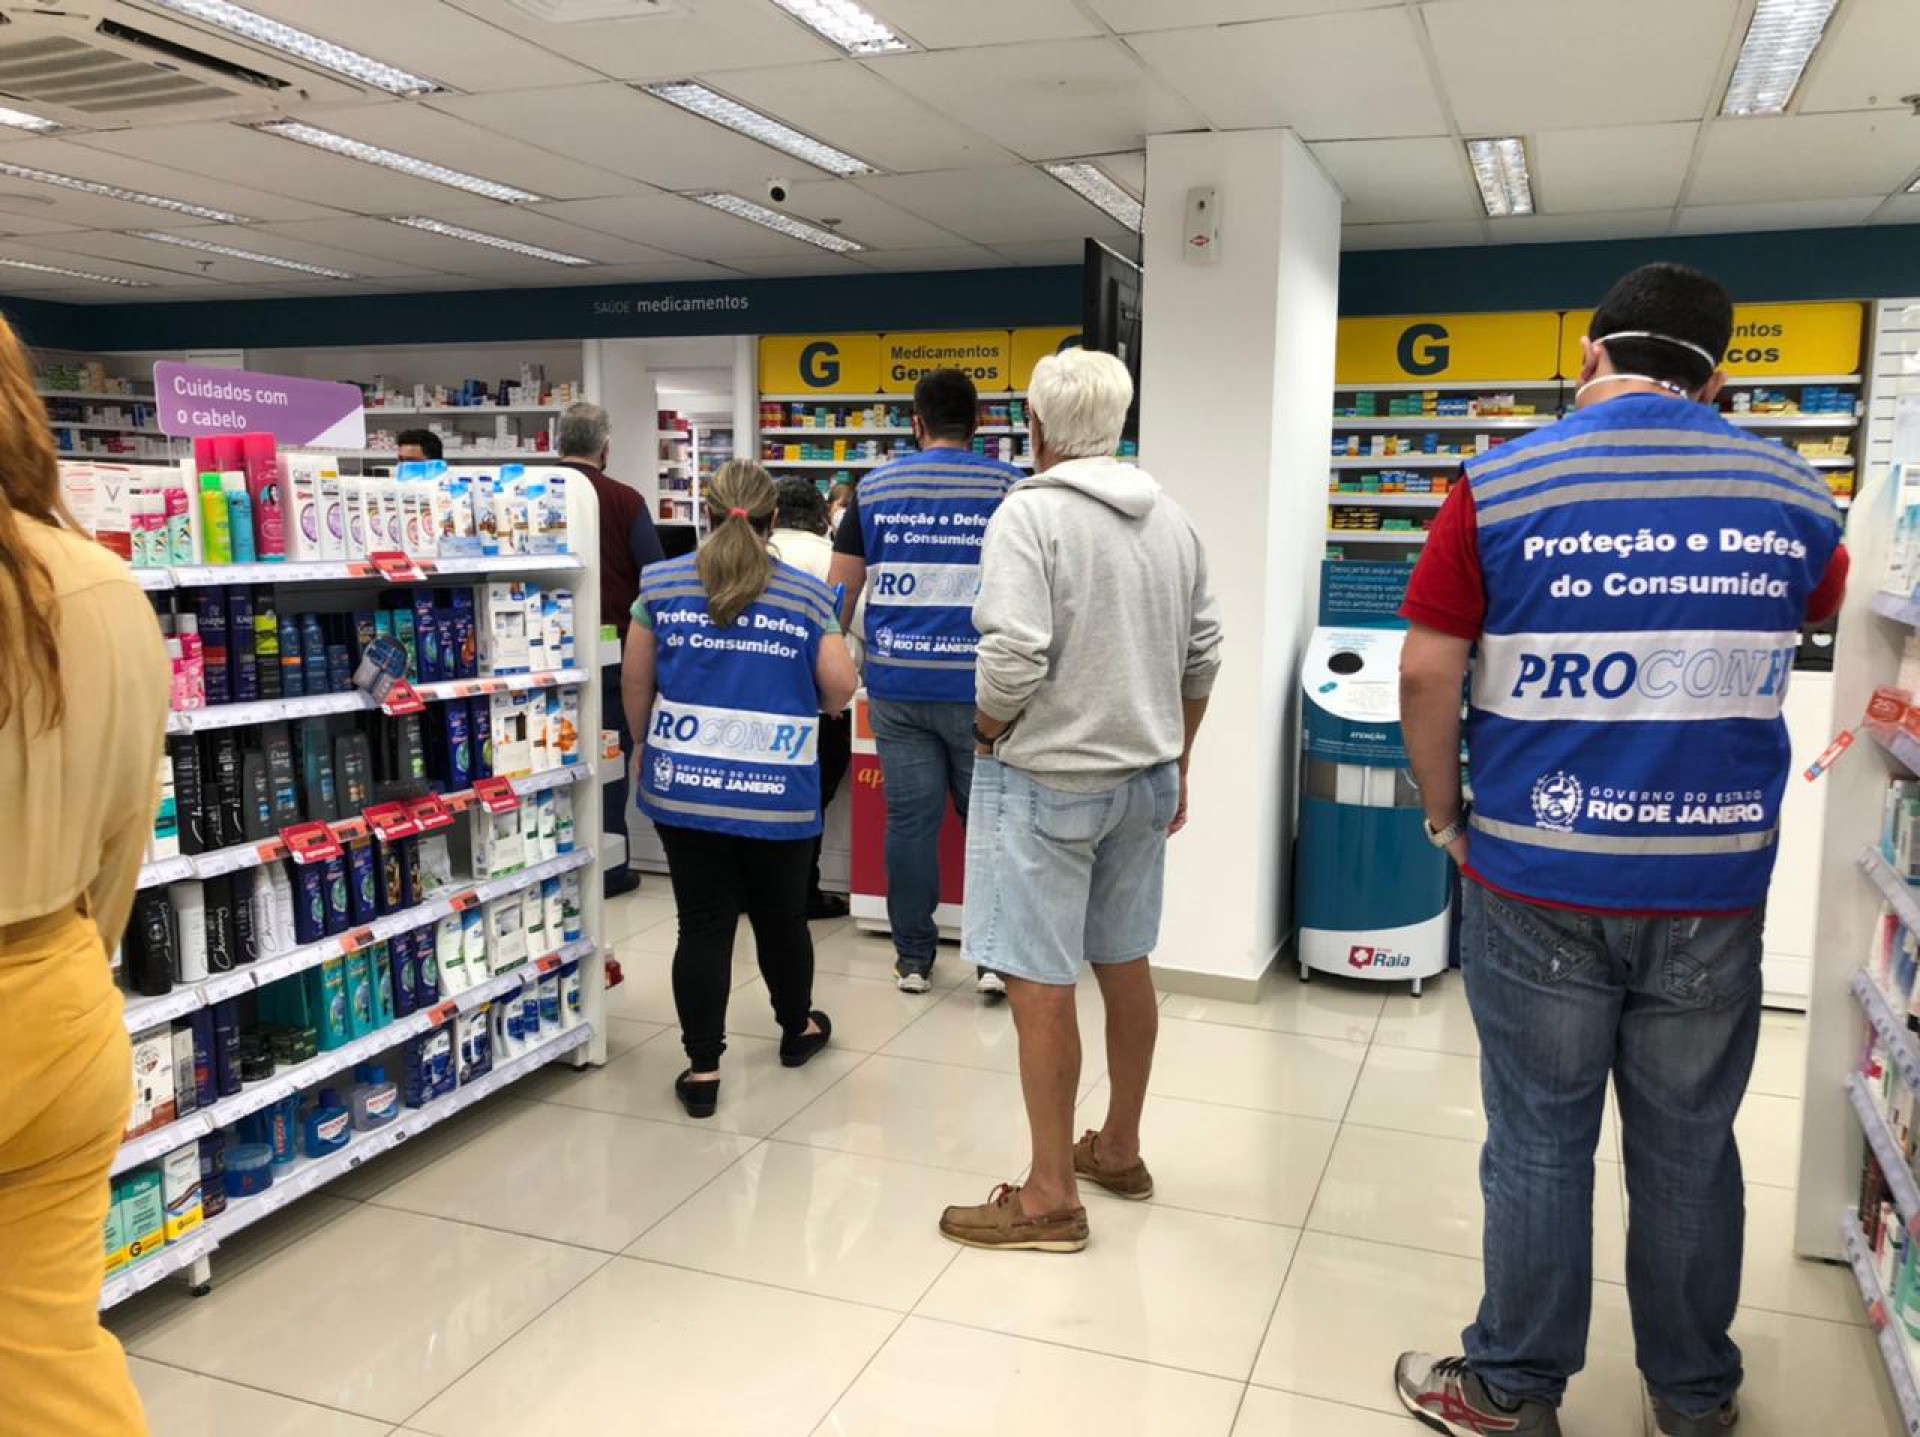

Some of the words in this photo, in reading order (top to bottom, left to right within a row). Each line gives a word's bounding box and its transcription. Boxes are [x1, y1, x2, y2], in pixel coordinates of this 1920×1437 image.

[636, 295, 749, 313] medicamentos
[890, 345, 1000, 360] Medicamentos
[1396, 323, 1450, 376] G
[799, 341, 841, 388] G
[173, 375, 252, 403] Cuidados
[256, 389, 289, 406] com
[177, 409, 188, 424] o
[192, 408, 247, 429] cabelo
[873, 512, 936, 527] Proteção
[939, 514, 949, 526] e
[953, 513, 990, 526] Defe
[903, 531, 985, 547] Consumido
[1523, 528, 1677, 561] Proteção
[1686, 533, 1709, 552] e
[1719, 528, 1807, 559] Defes
[1549, 574, 1593, 598] do
[656, 609, 716, 628] Proteç
[737, 615, 750, 627] e
[666, 633, 685, 647] do
[689, 633, 799, 660] Consumidor
[675, 771, 701, 787] RIO
[702, 775, 723, 790] DE
[1589, 786, 1675, 802] GOVERNO
[1683, 791, 1706, 804] DO
[1715, 789, 1762, 804] ESTADO
[1586, 800, 1633, 823] RIO
[1637, 803, 1671, 823] DE
[1373, 952, 1411, 967] Raia
